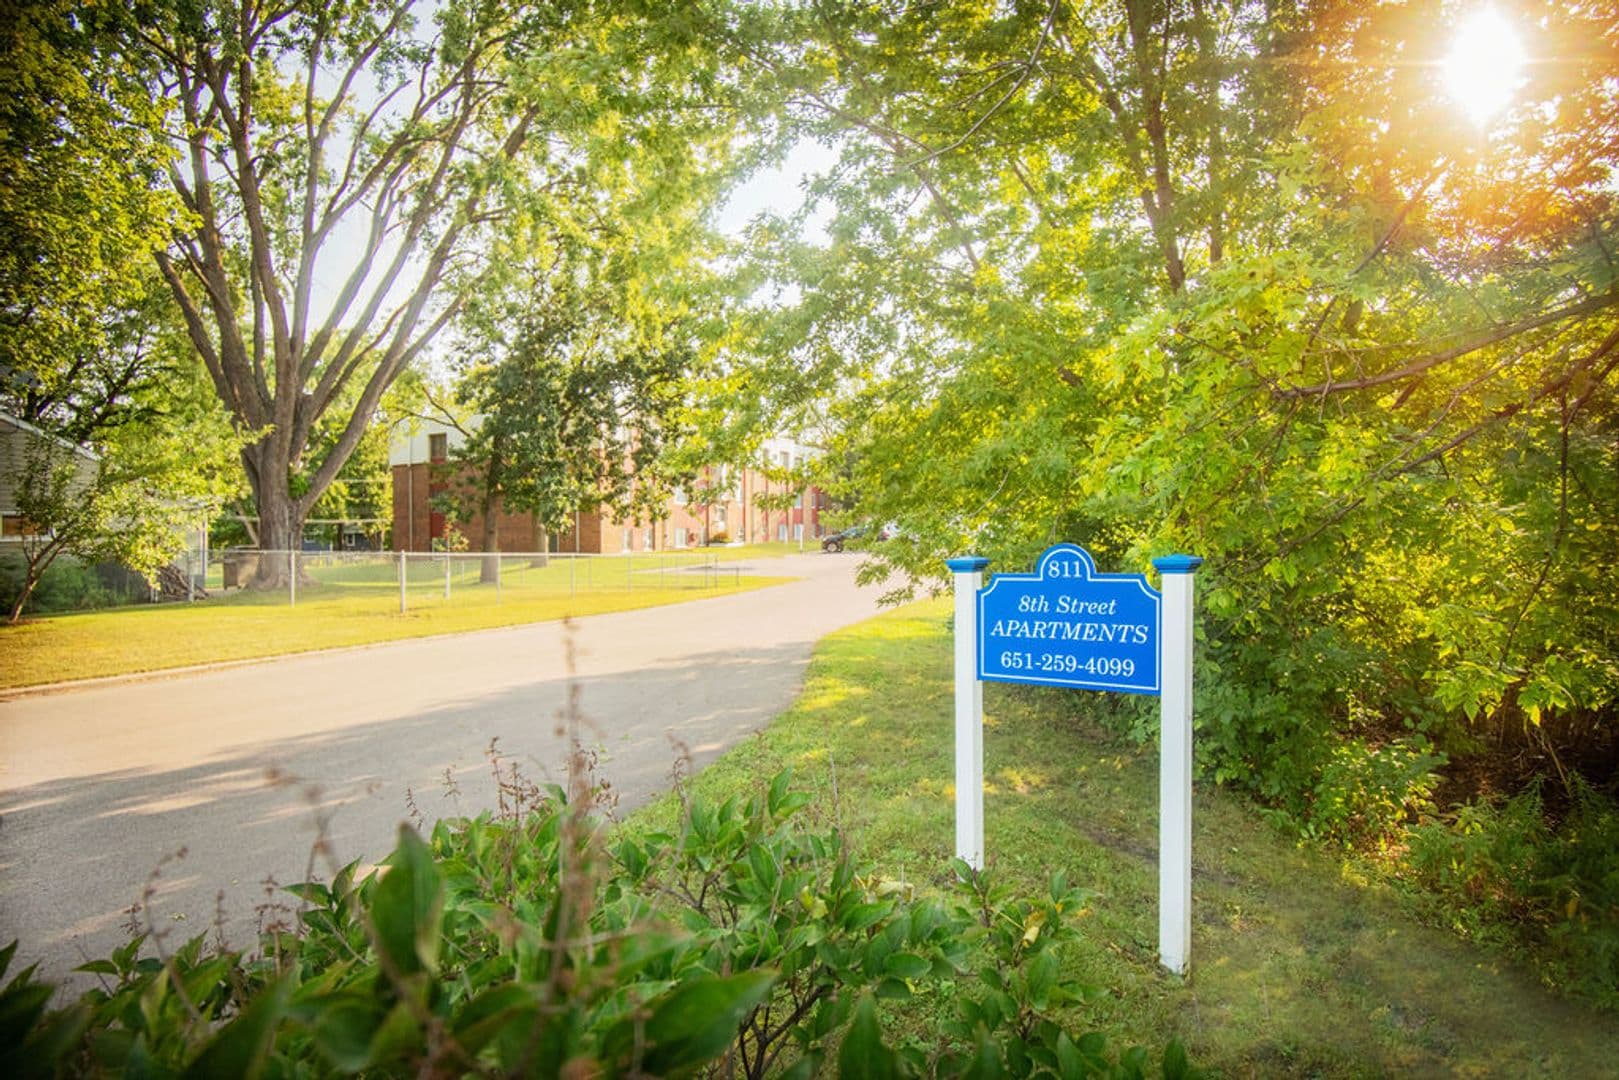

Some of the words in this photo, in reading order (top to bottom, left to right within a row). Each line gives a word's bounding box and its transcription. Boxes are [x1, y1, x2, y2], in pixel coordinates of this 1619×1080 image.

[1048, 559, 1082, 578] 811
[1018, 595, 1050, 613] 8th
[1056, 595, 1117, 615] Street
[990, 619, 1149, 645] APARTMENTS
[1000, 651, 1135, 677] 651-259-4099
